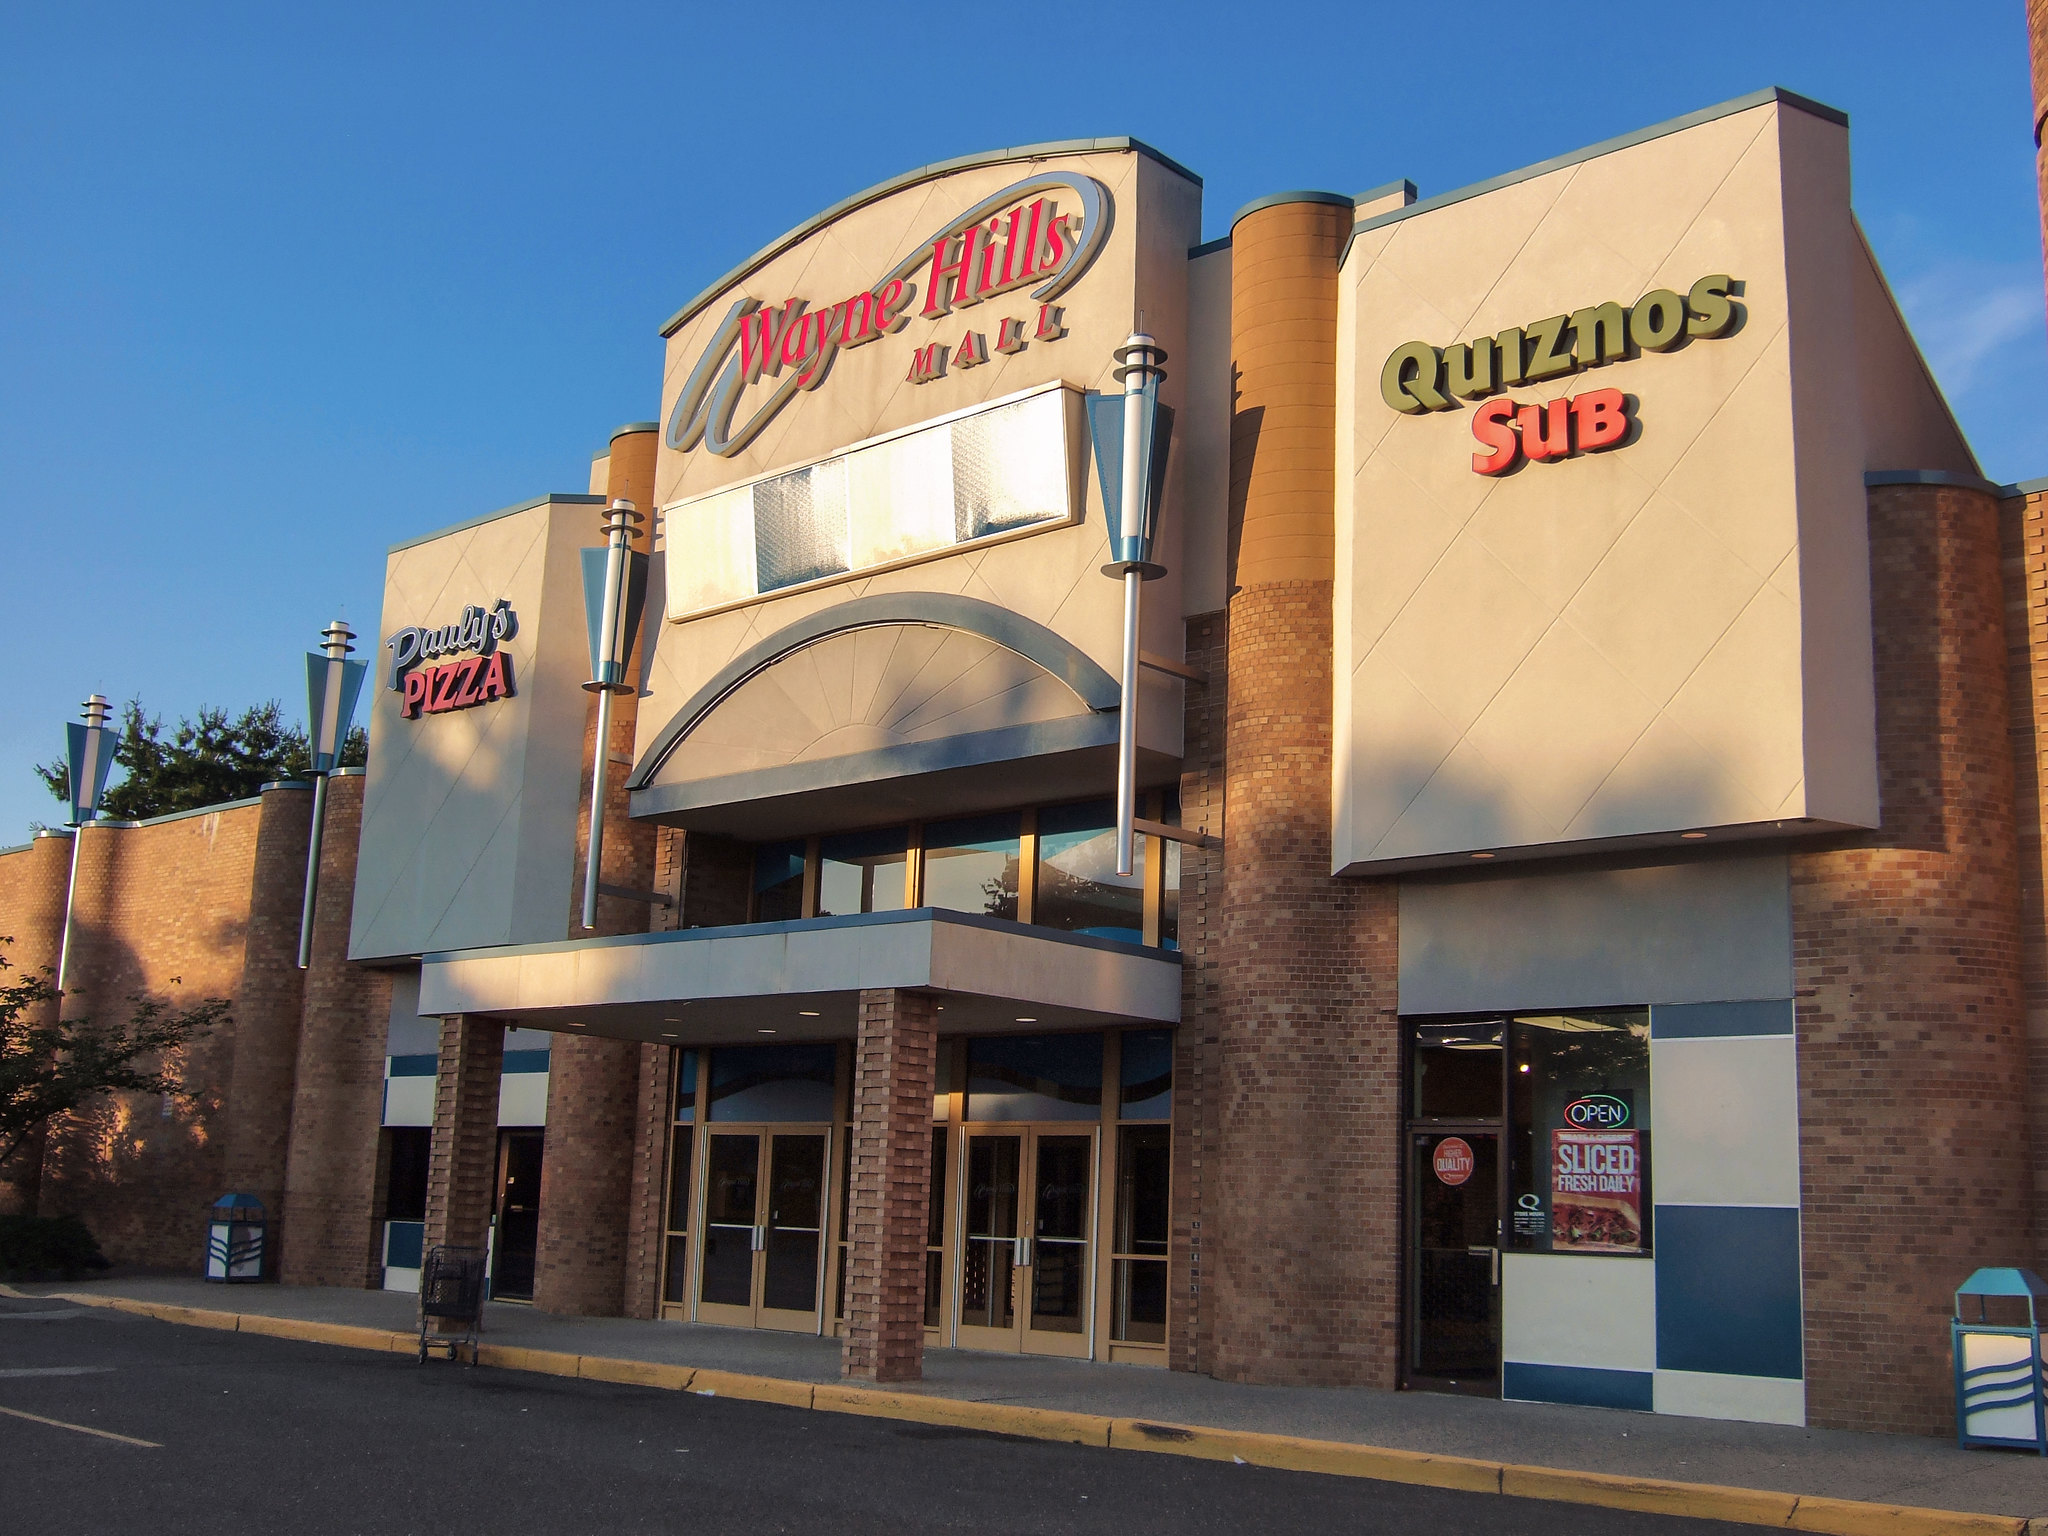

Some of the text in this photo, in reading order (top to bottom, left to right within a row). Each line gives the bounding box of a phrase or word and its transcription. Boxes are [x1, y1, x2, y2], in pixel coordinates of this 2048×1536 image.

[738, 197, 1081, 391] Wayne Hills
[906, 303, 1068, 385] MALL
[385, 598, 519, 691] Pauly's
[401, 651, 518, 719] PIZZA
[1571, 1104, 1621, 1122] OPEN
[1437, 1157, 1471, 1171] QUALITY
[1558, 1144, 1635, 1175] SLICED
[1558, 1174, 1635, 1192] FRESH DAILY
